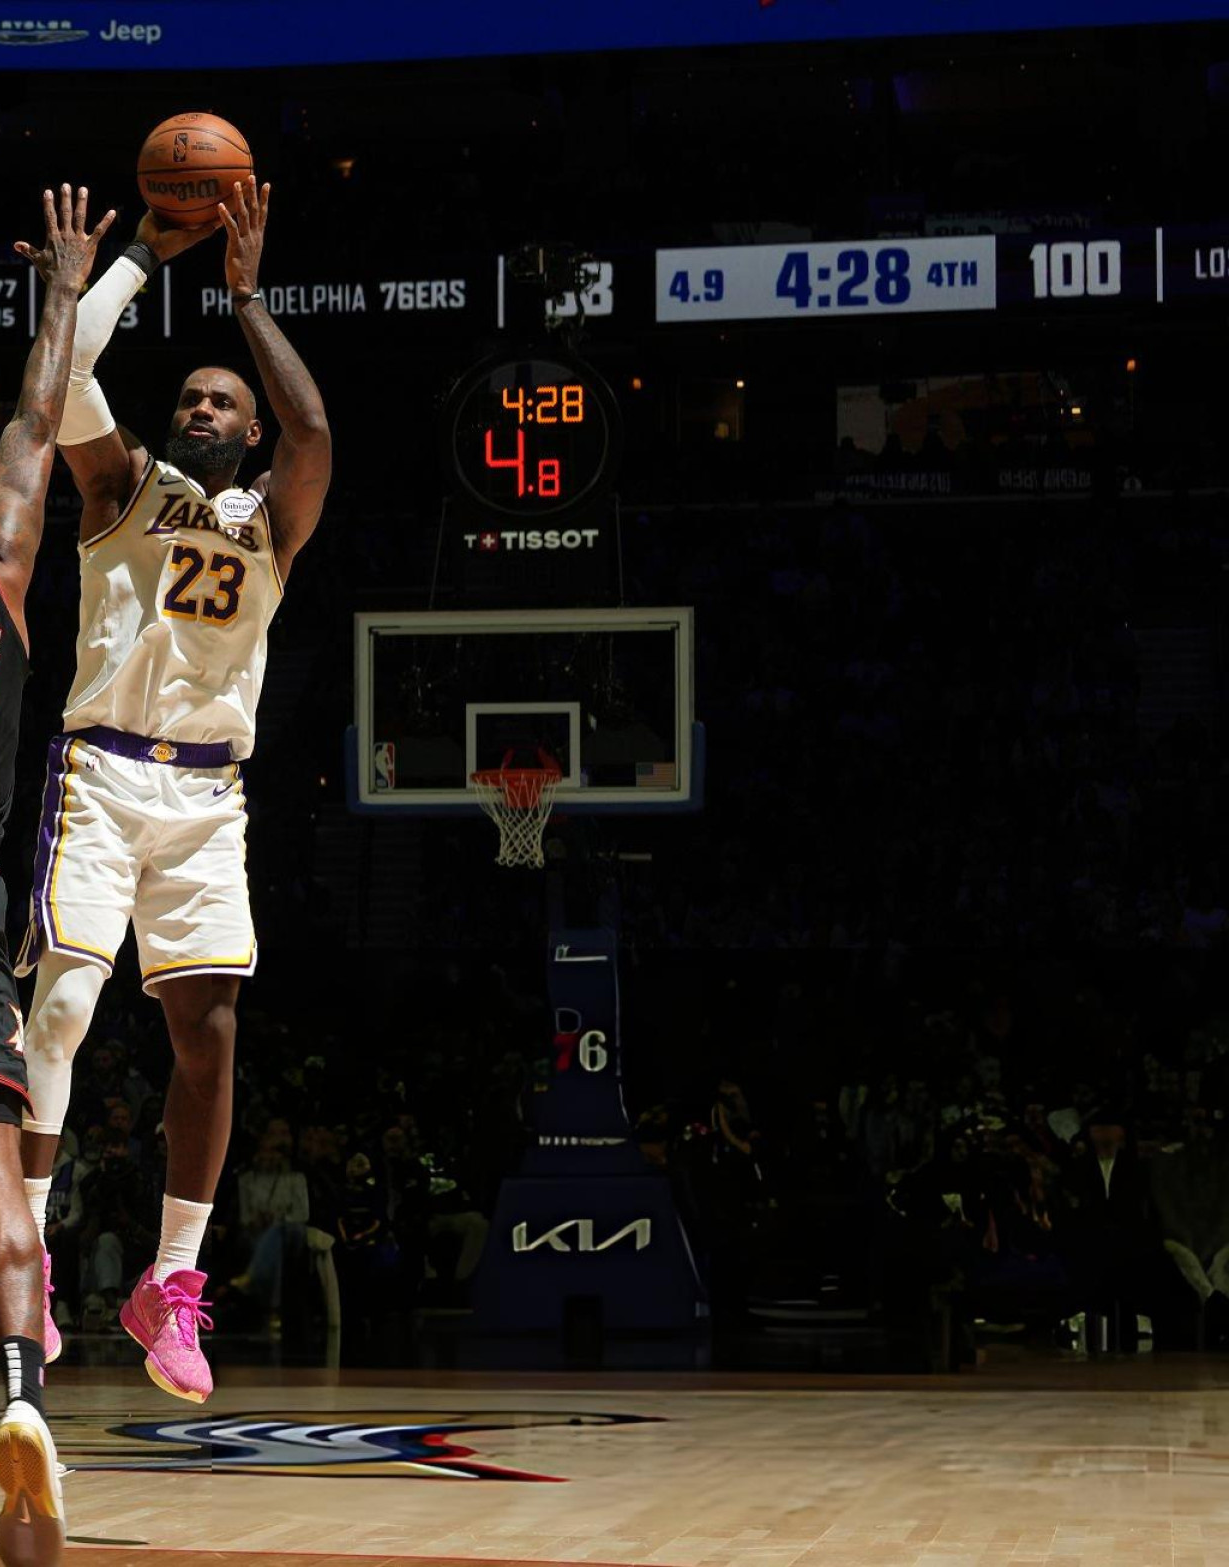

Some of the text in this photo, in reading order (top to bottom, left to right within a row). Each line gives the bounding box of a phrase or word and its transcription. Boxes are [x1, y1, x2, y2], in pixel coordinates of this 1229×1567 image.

[100, 20, 161, 45] Jeep
[669, 247, 977, 309] 4.9 4:28 4TH
[1030, 241, 1121, 297] 100
[1194, 247, 1229, 279] LO
[202, 280, 465, 316] PHDELPHIA 76ERS
[503, 385, 583, 424] 4:28
[485, 429, 560, 496] 4.8
[224, 502, 254, 512] bibigo
[161, 544, 247, 626] 23
[512, 1218, 652, 1252] KIA
